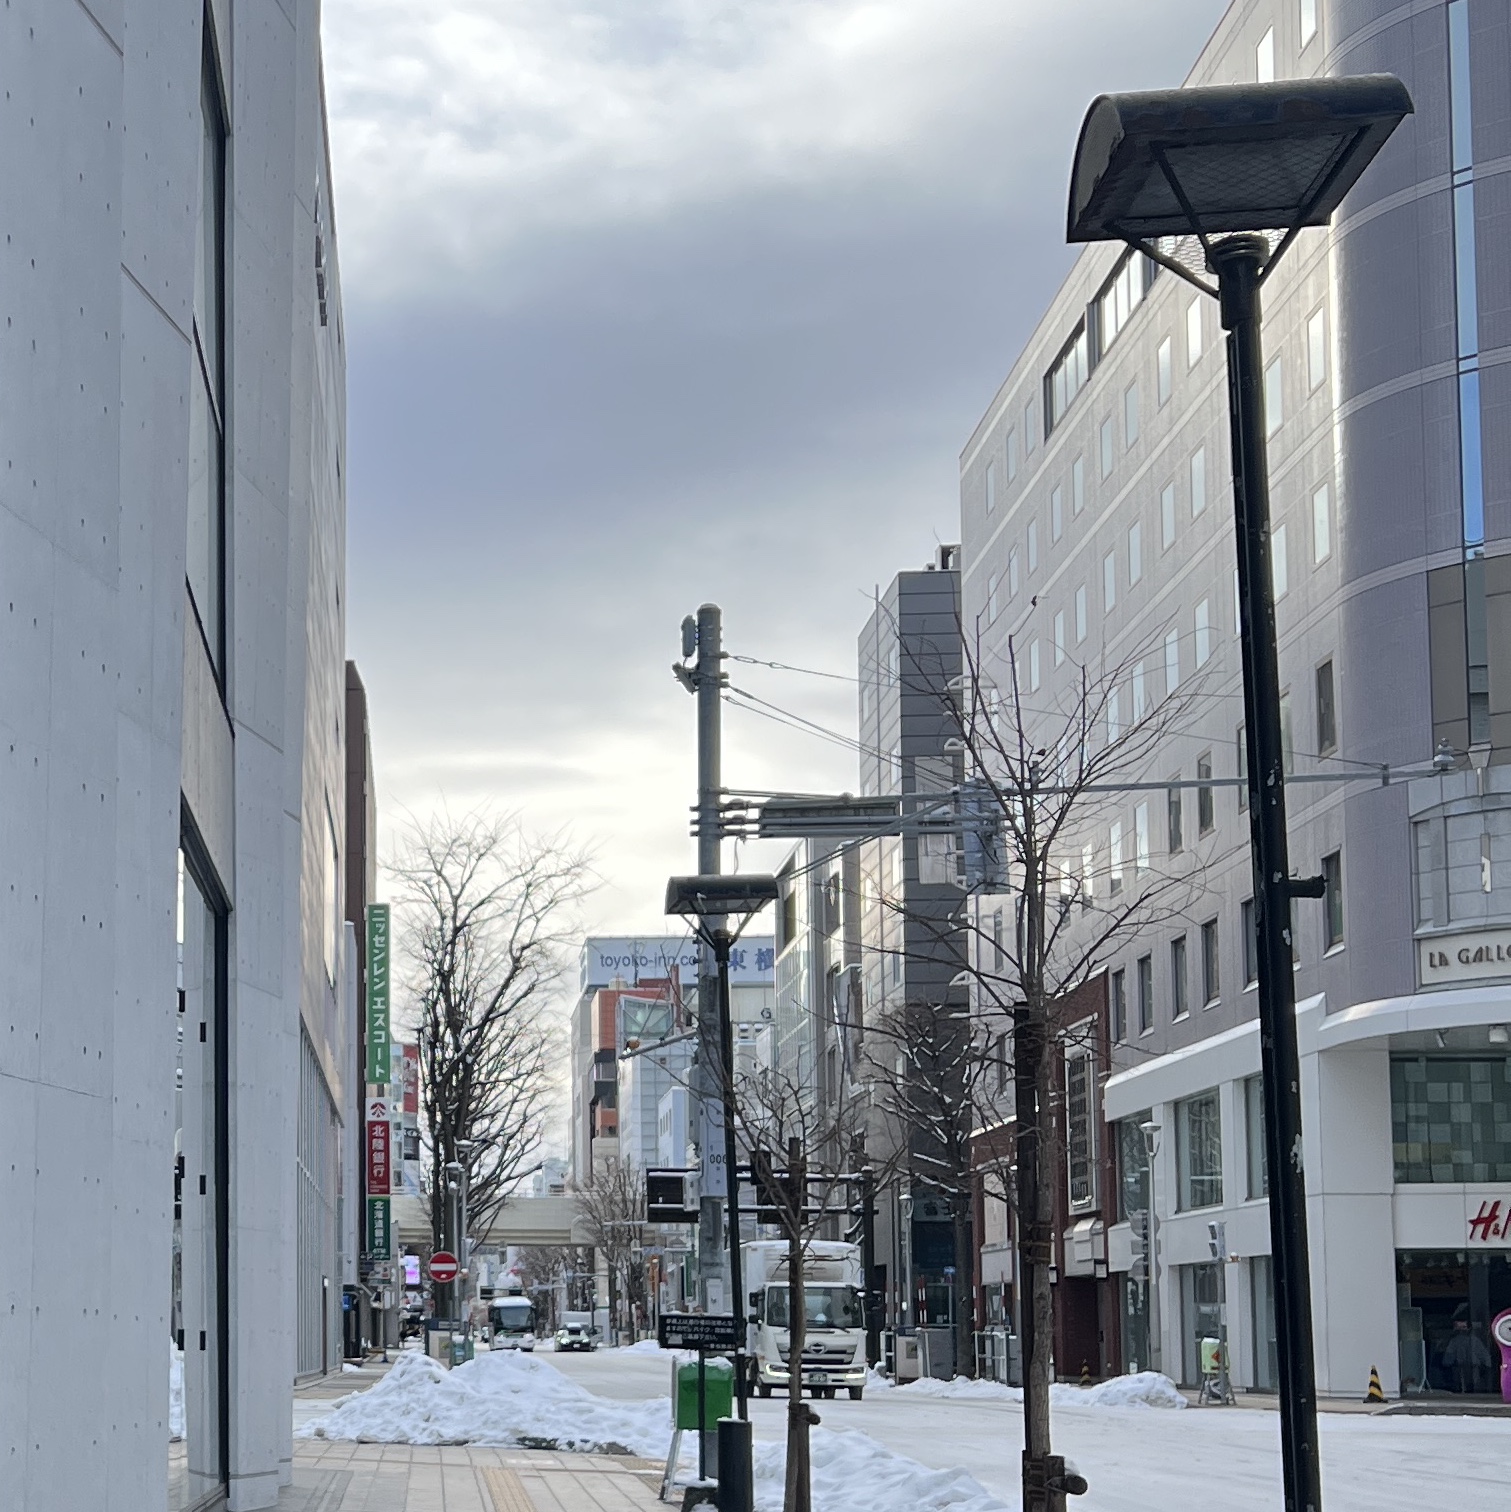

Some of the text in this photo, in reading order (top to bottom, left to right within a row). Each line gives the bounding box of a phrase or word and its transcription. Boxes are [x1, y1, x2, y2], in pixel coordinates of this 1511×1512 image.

[372, 909, 386, 1078] ニッセンレン エスコート
[1429, 951, 1449, 968] LA
